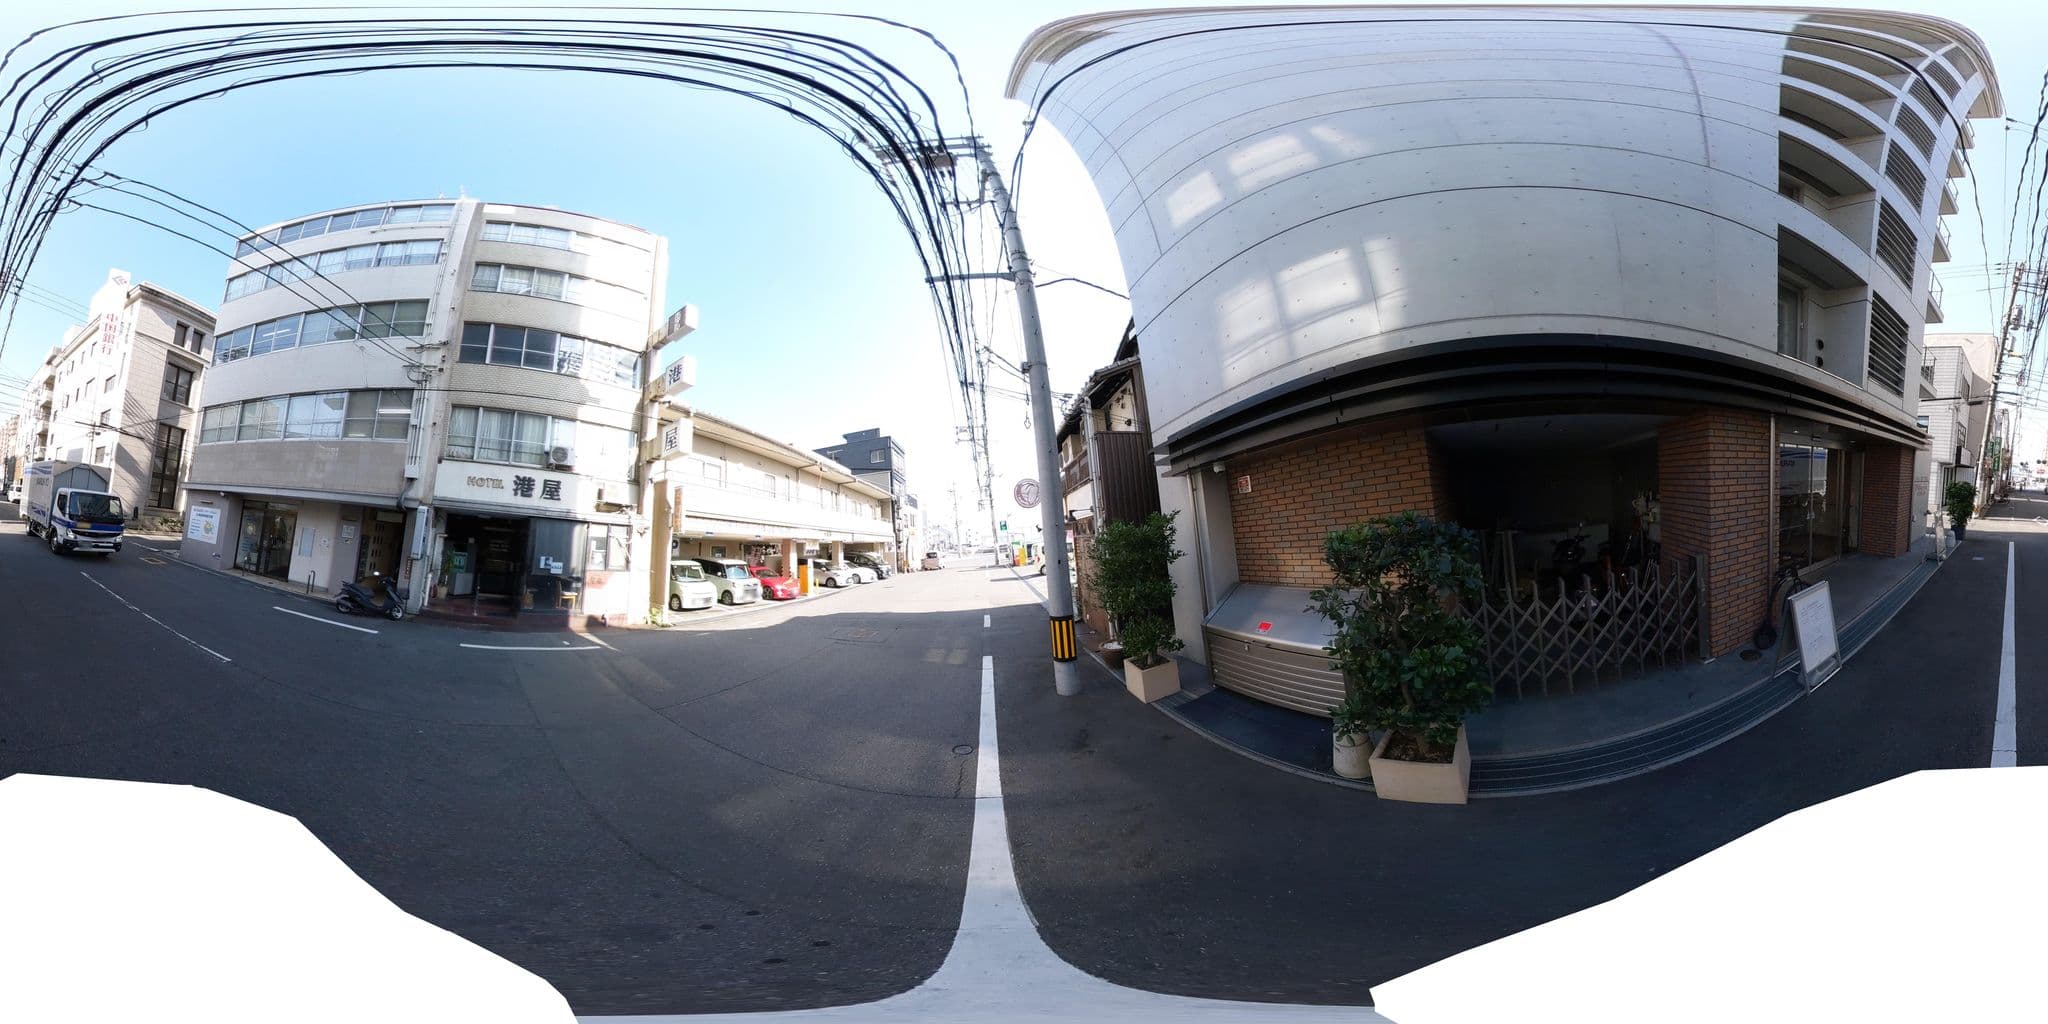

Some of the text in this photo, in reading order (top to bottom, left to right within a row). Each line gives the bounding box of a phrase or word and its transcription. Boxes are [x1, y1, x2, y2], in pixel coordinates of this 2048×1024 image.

[102, 313, 118, 355] 中国銀行
[467, 475, 561, 500] HOTEL 港屋
